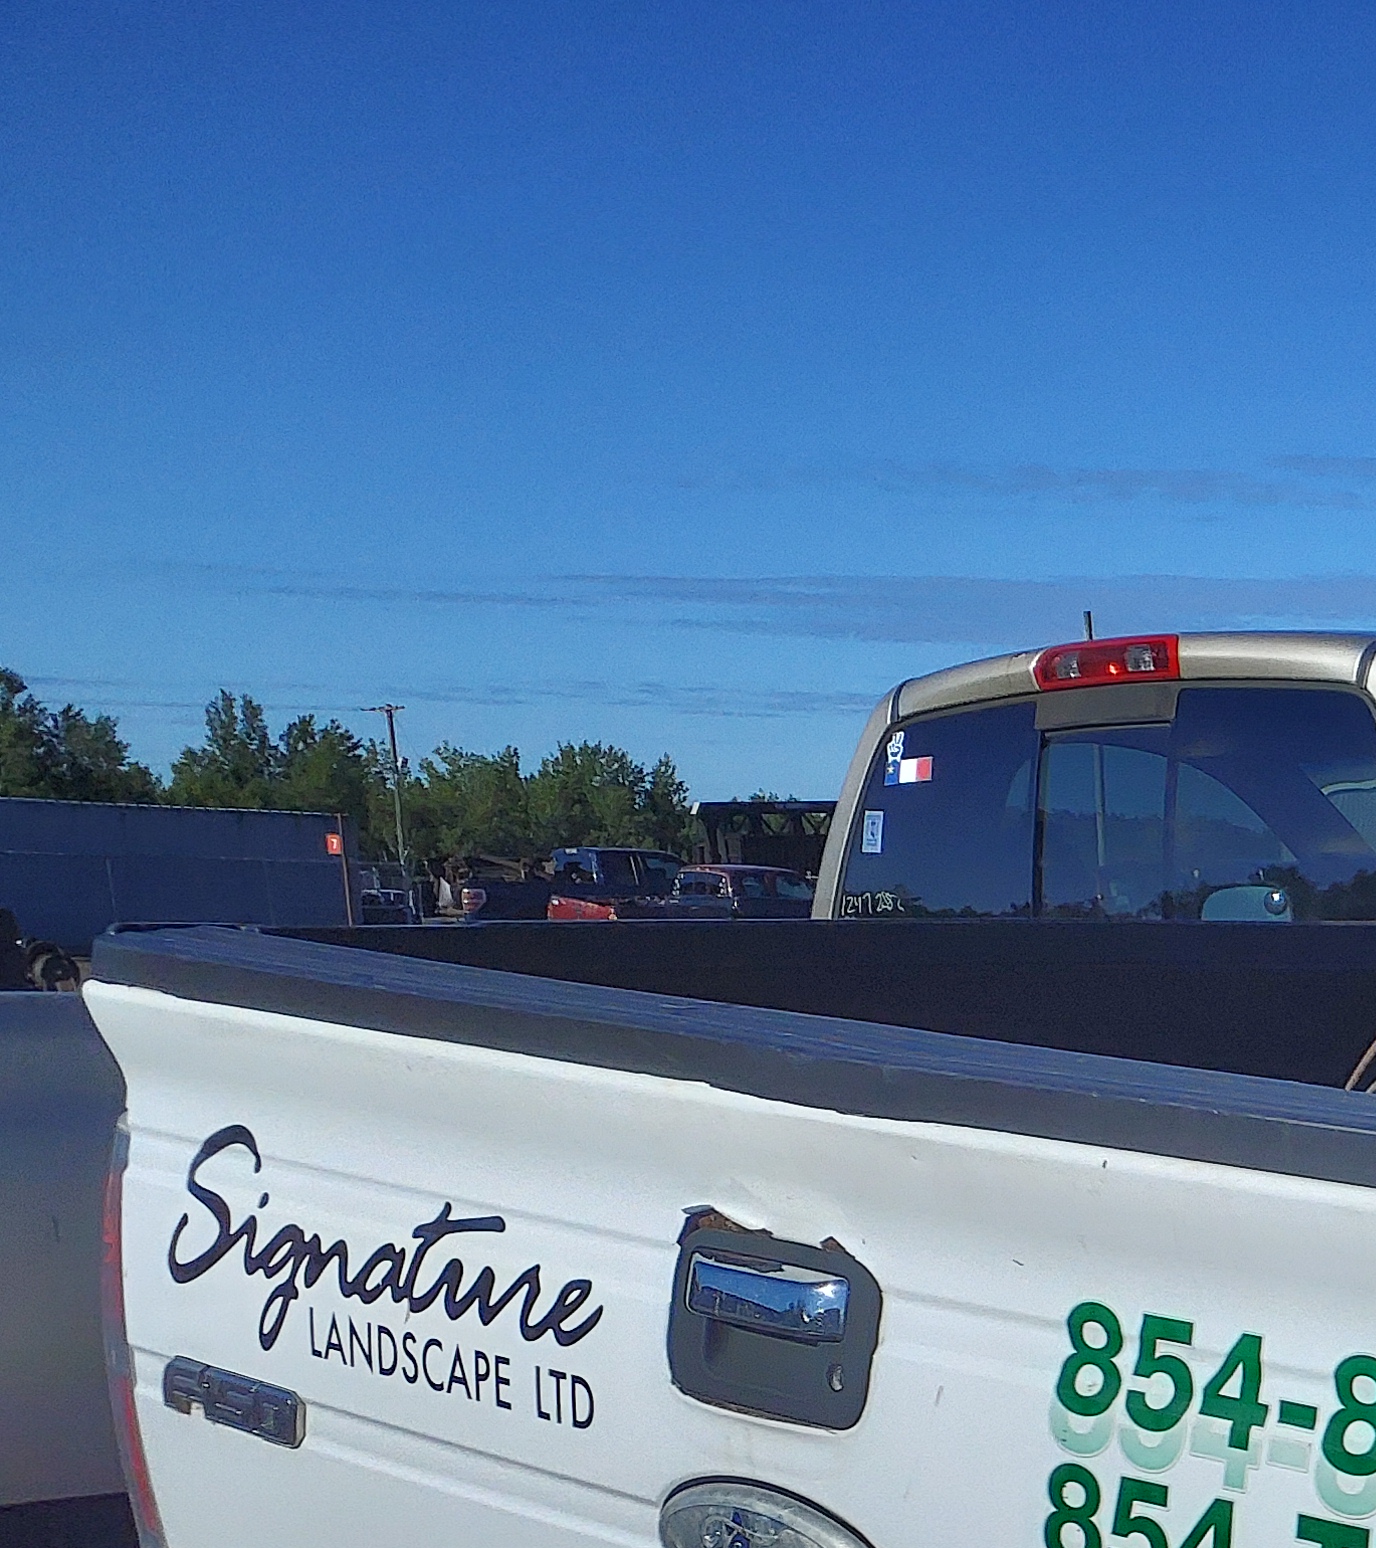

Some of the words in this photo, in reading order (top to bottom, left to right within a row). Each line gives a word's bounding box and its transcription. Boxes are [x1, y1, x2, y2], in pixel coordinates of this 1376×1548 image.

[168, 1124, 604, 1352] Signature
[308, 1305, 512, 1412] LANDSCAPE
[535, 1365, 595, 1431] LTD
